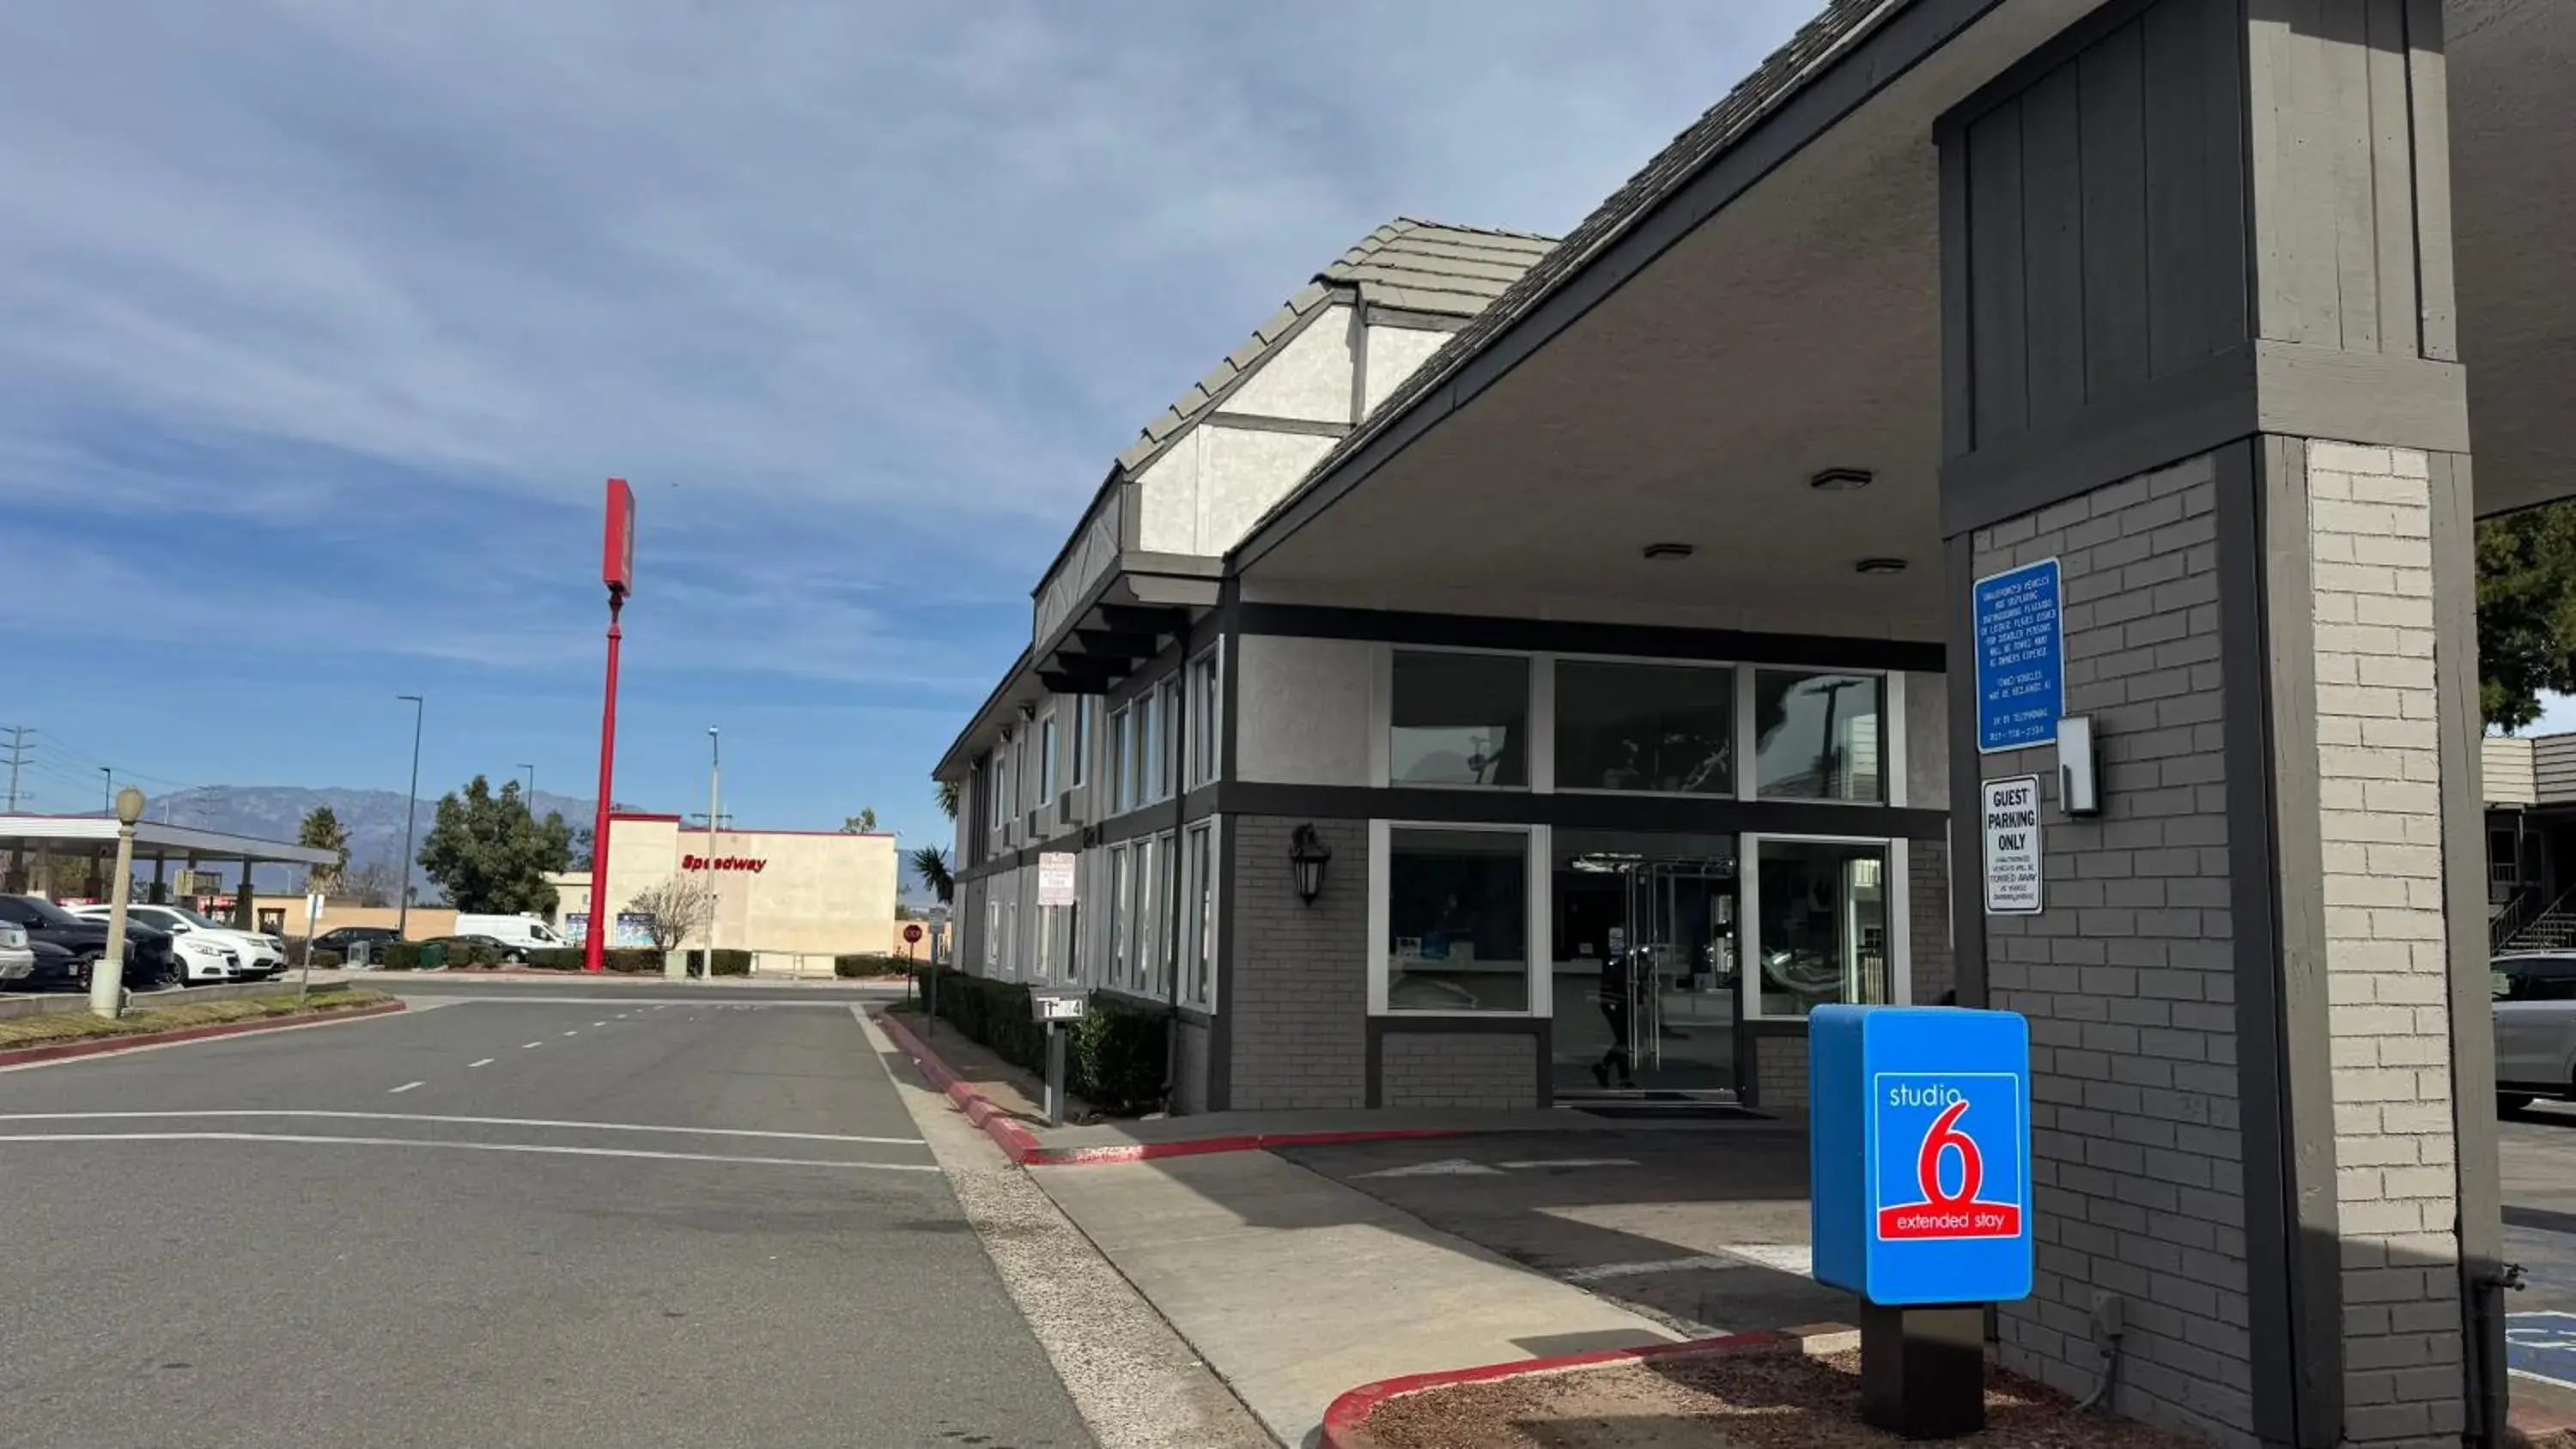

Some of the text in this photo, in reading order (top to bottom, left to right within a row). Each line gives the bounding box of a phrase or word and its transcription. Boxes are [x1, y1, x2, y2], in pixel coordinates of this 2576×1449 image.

[1993, 787, 2030, 807] GUEST
[1988, 809, 2035, 830] PARKING
[1998, 833, 2026, 851] ONLY
[1889, 1083, 1962, 1107] studio
[1917, 1099, 1984, 1204] 6
[1896, 1212, 2006, 1232] extended stay
